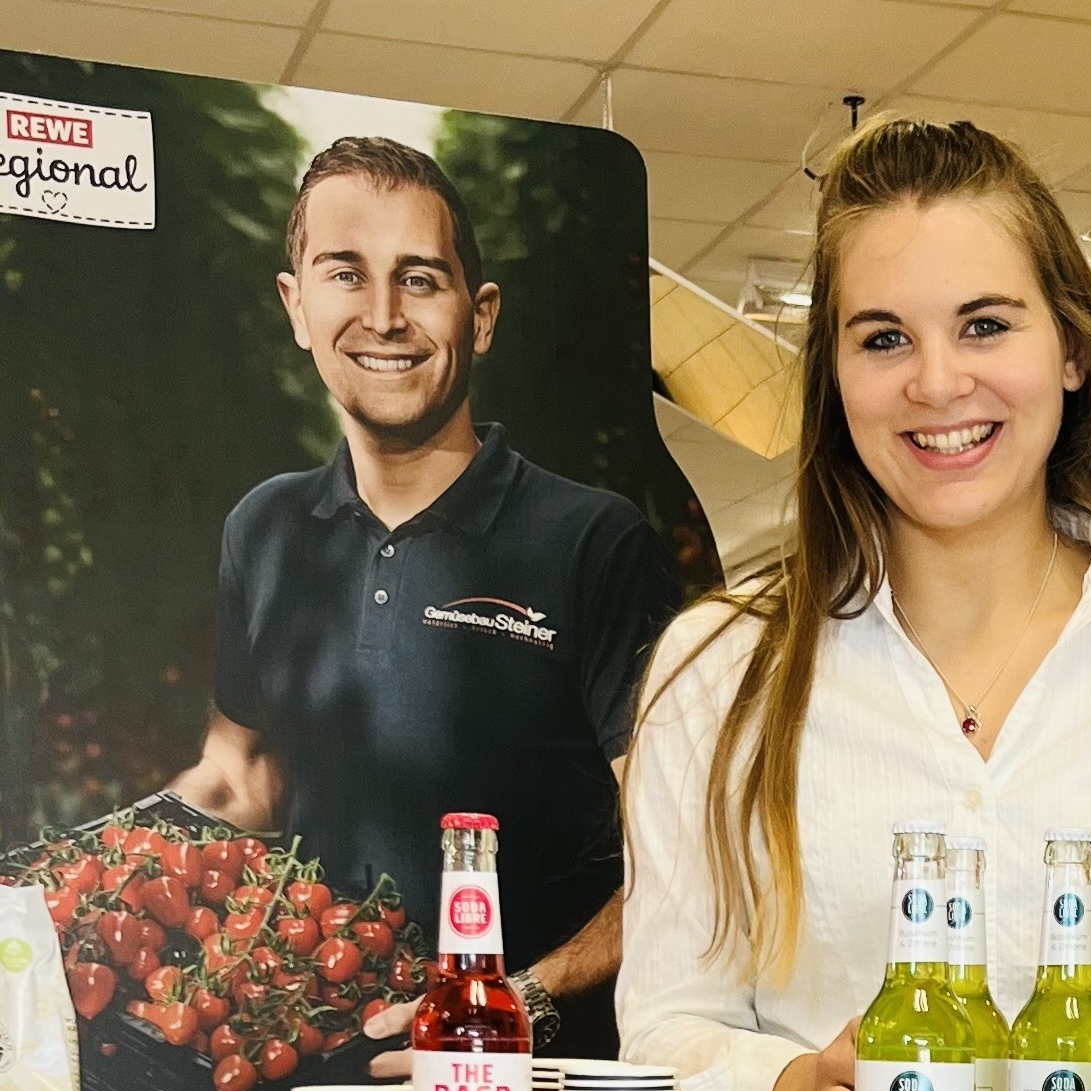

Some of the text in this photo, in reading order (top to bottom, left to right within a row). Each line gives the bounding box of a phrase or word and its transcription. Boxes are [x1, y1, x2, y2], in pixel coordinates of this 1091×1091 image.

[10, 113, 90, 144] REWE
[452, 1063, 493, 1083] THE
[898, 1078, 923, 1091] SOD
[1050, 1077, 1076, 1090] SODA
